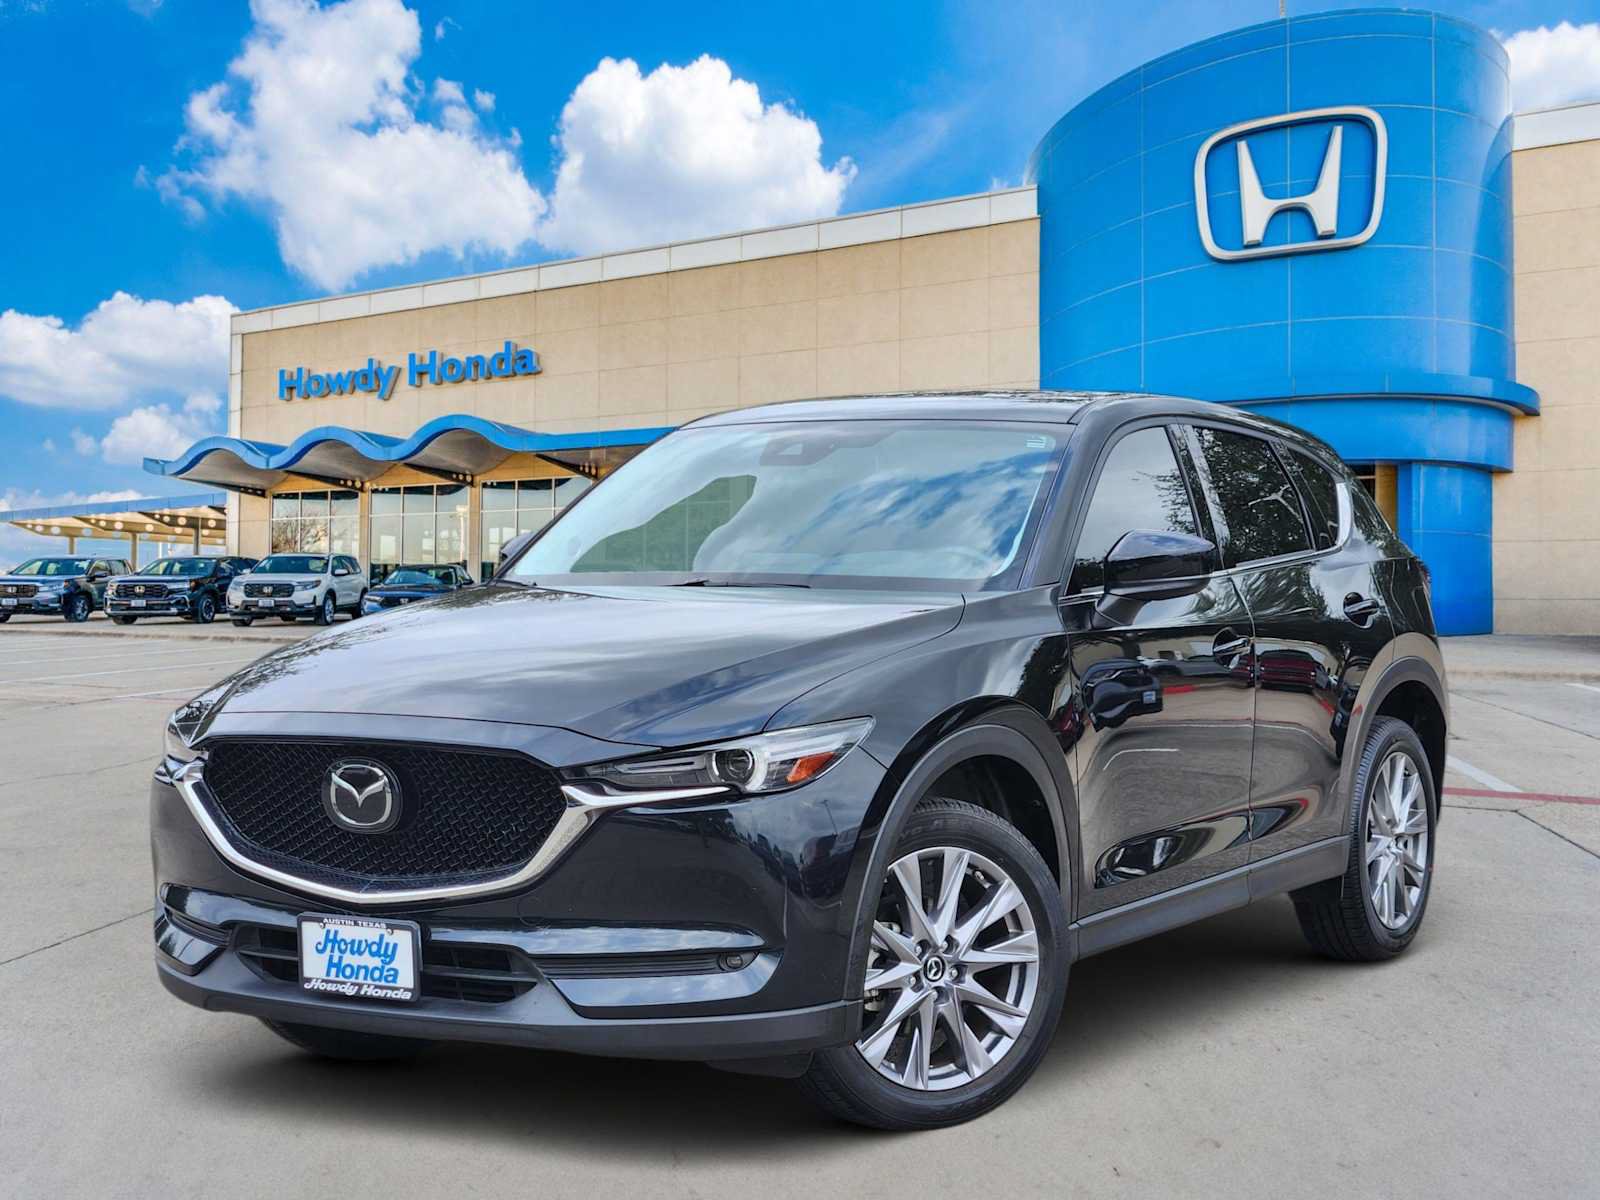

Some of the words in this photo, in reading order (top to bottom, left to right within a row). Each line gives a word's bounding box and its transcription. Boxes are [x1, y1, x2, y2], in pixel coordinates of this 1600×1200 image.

[278, 358, 401, 400] Howdy
[407, 340, 541, 387] Honda
[323, 918, 355, 927] AUSTIN
[357, 921, 387, 929] TEXAS
[315, 929, 399, 965] Howdy
[325, 954, 399, 984] Honda
[303, 979, 358, 996] Howdy
[360, 984, 412, 1000] Honda
